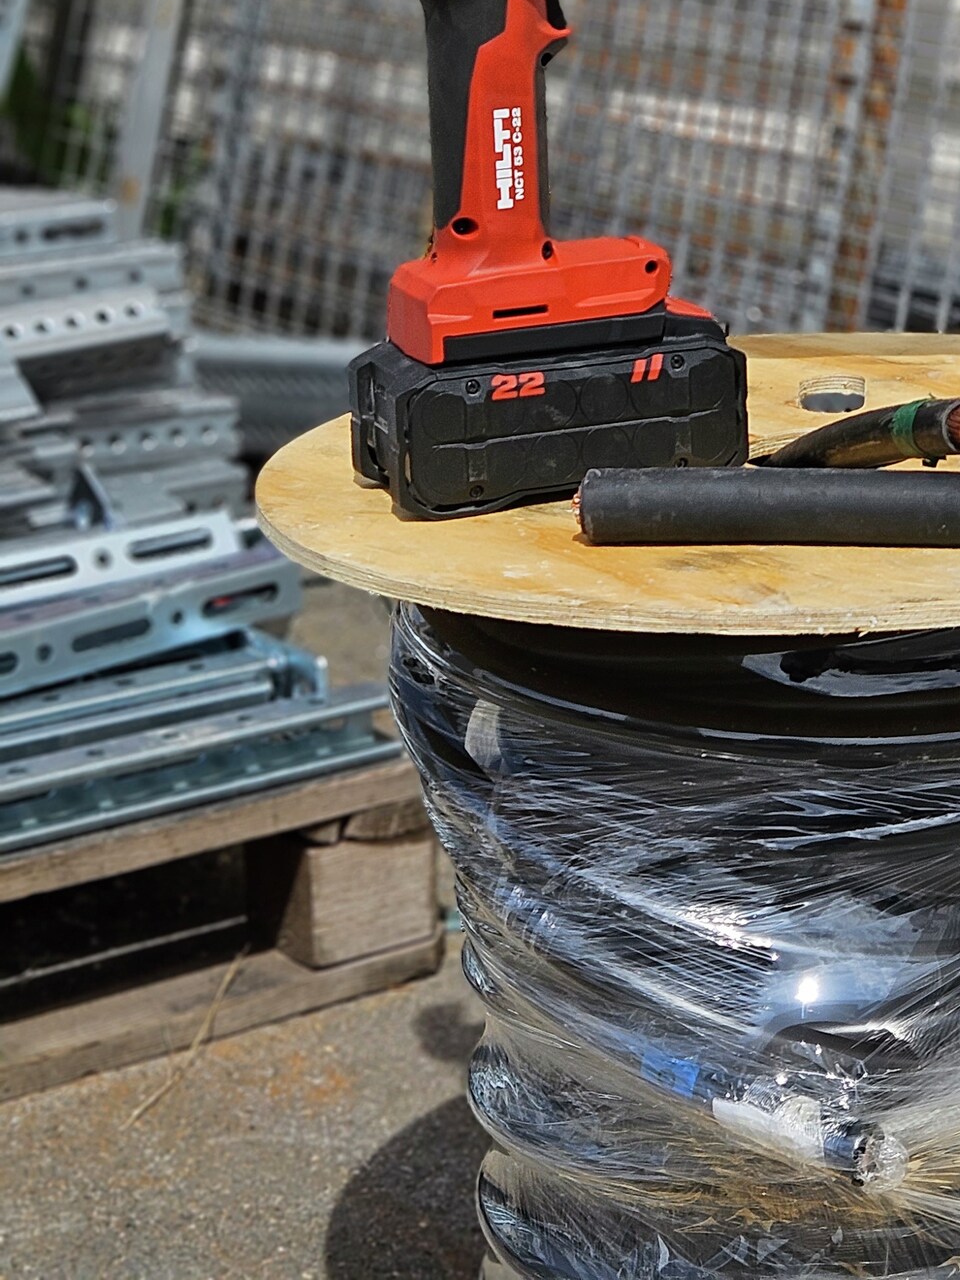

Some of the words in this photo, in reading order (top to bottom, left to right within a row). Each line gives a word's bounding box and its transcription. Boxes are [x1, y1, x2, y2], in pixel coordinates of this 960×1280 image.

[511, 106, 523, 144] C-22
[493, 107, 515, 210] HILTI
[514, 169, 525, 201] NCT
[490, 371, 546, 402] 22
